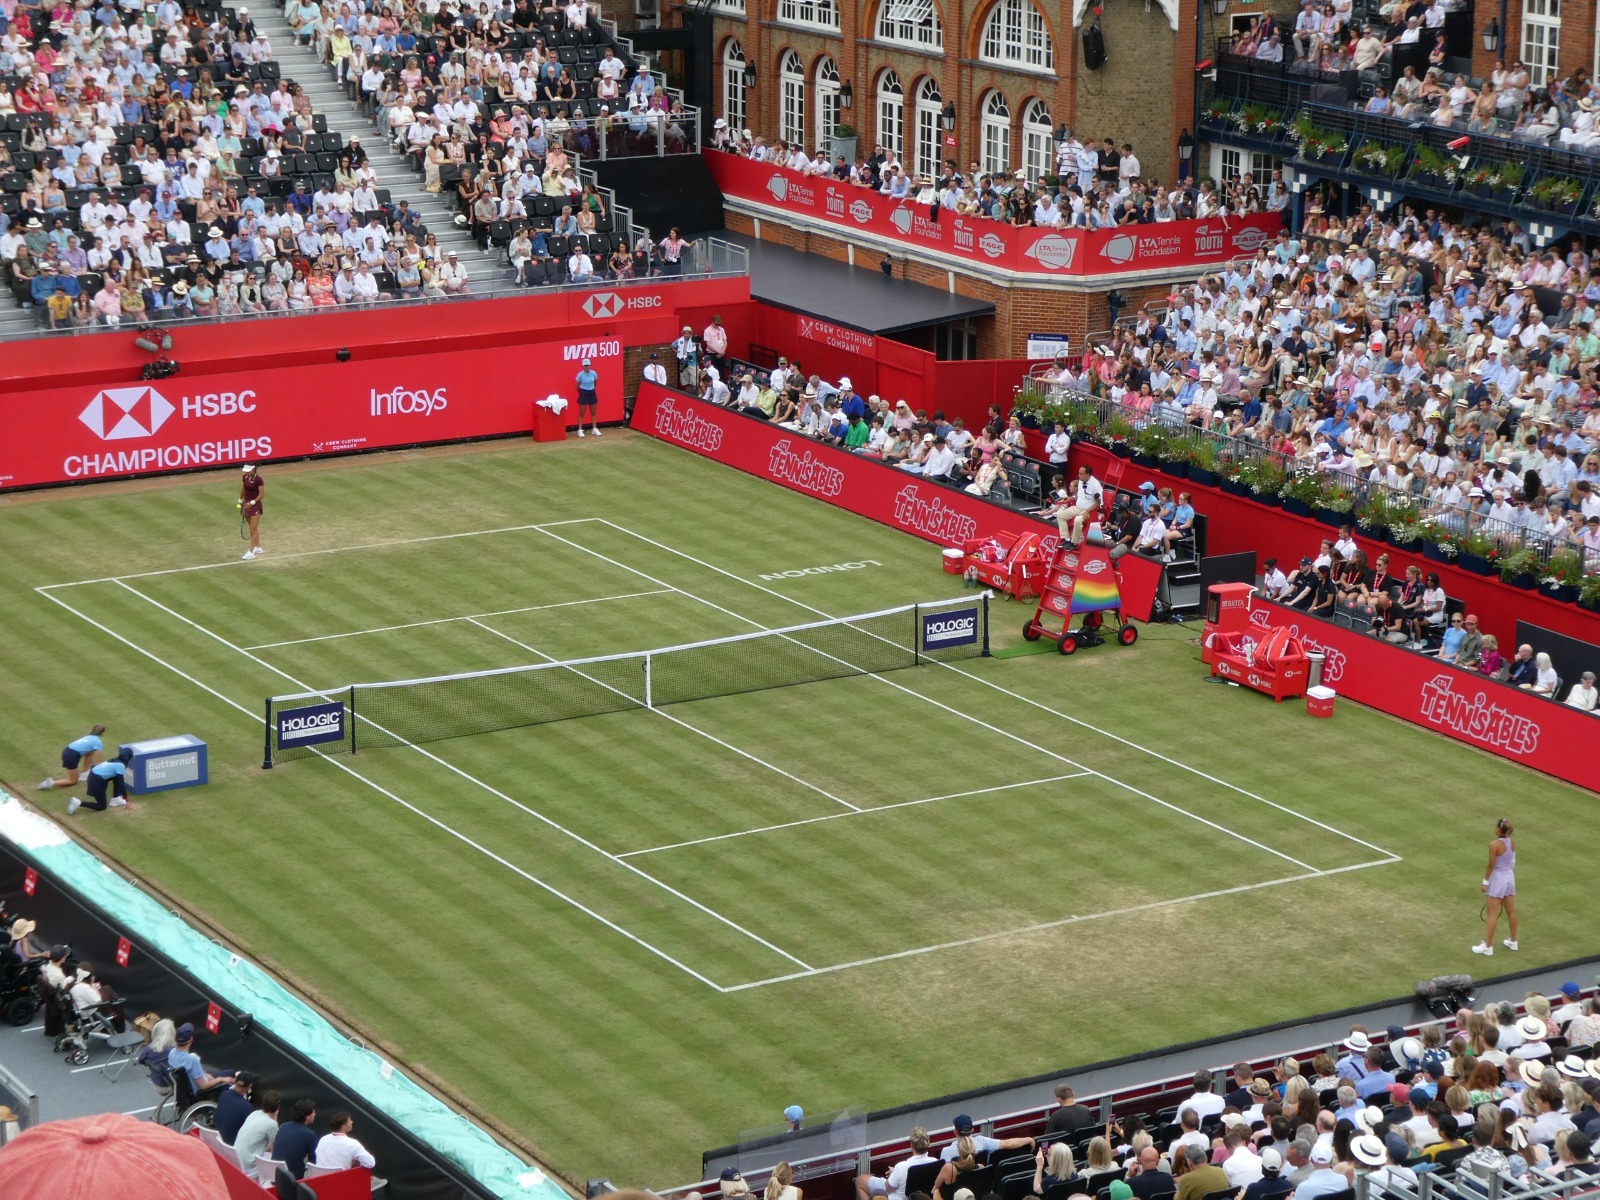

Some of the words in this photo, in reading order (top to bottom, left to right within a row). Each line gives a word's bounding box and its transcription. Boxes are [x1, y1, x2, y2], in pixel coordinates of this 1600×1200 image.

[789, 184, 800, 195] LTA
[800, 186, 814, 197] Tennis
[789, 192, 814, 206] Foundation
[826, 197, 844, 213] YOUTH
[914, 216, 926, 228] LTA
[926, 219, 941, 230] Tennis
[914, 225, 942, 240] Foundation
[954, 230, 973, 247] YOUTH
[1139, 238, 1157, 248] LTA
[1157, 236, 1180, 245] Tennis
[1195, 235, 1223, 250] YOUTH
[1139, 246, 1180, 257] Foundation
[628, 296, 662, 309] HSBC
[815, 322, 834, 334] CREW
[836, 329, 872, 347] CLOTHING
[564, 343, 597, 360] WTA
[600, 341, 619, 356] 500
[827, 337, 860, 354] COMPANY
[182, 390, 256, 418] HSBC
[371, 386, 447, 416] Infosys
[64, 436, 272, 476] CHAMPIONSHIPS
[758, 560, 882, 580] LONDON
[927, 617, 973, 634] HOLOGIC
[282, 712, 339, 731] HOLOGIC
[149, 756, 195, 770] Butternut
[149, 771, 166, 780] Box
